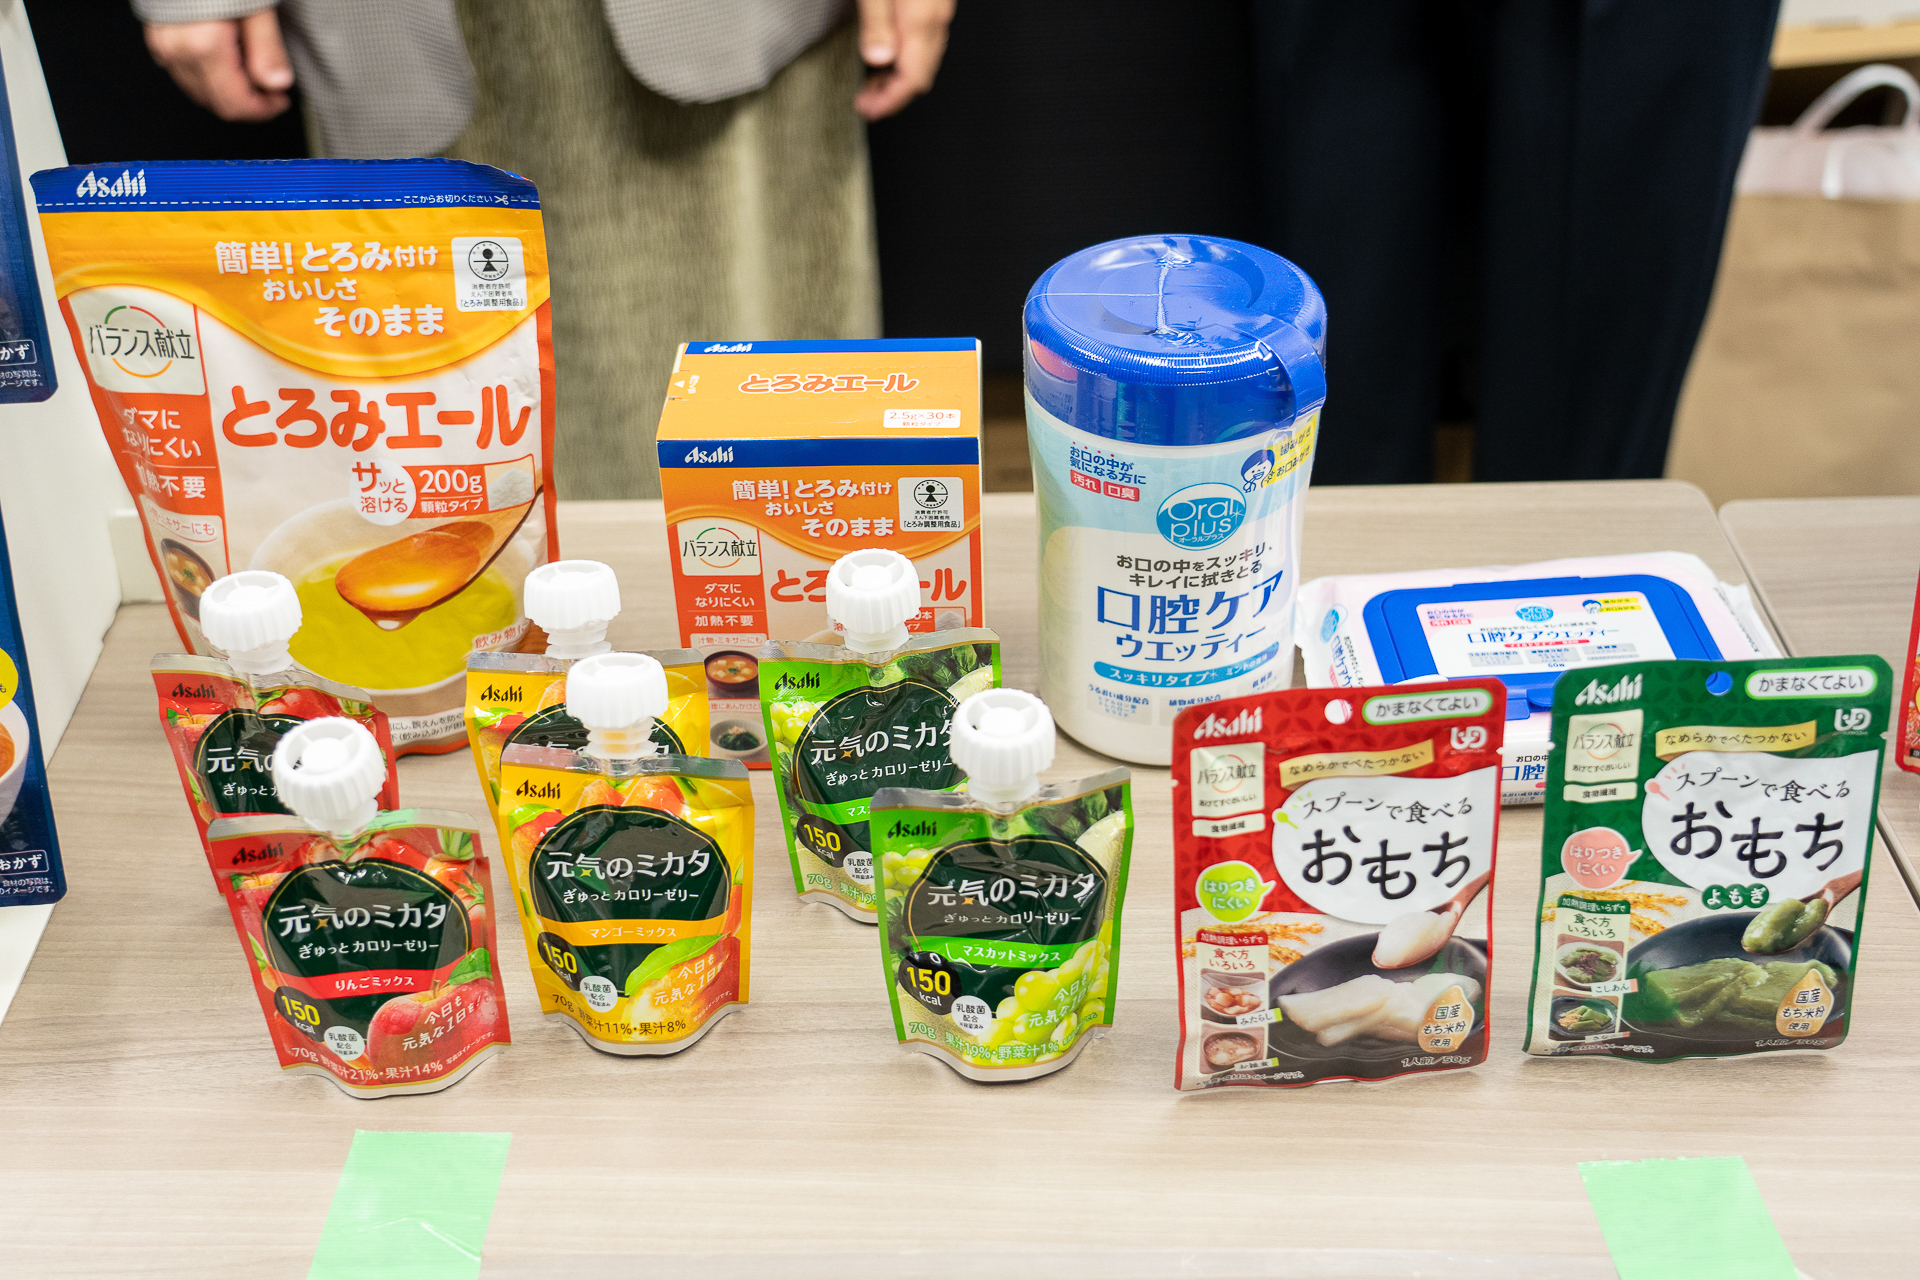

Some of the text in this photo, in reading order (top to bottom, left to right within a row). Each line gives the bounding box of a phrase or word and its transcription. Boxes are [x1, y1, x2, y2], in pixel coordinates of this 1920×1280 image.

[76, 169, 147, 199] Asahi
[403, 194, 493, 205] ここからお切りください
[262, 278, 358, 303] おいしさ
[314, 305, 445, 336] そのまま
[89, 325, 195, 360] バランス献立
[703, 343, 753, 353] Asahi
[738, 373, 920, 393] とろみエール
[124, 407, 181, 430] ダマに
[222, 384, 532, 452] とろみエール
[889, 411, 956, 420] 2.5g×30本
[122, 427, 202, 459] なりにくい
[684, 446, 734, 464] Asahi
[1070, 446, 1134, 472] お口の中が
[352, 461, 406, 494] サッと
[1070, 456, 1146, 484] 気になる方に
[419, 469, 483, 494] 200g
[1073, 472, 1135, 500] 汚れ 口臭
[361, 496, 408, 513] 溶ける
[421, 498, 483, 514] 顆粒タイプ
[765, 501, 834, 516] おいしさ
[1168, 498, 1234, 521] Oral
[801, 517, 894, 537] そのまま
[1171, 518, 1231, 541] plus
[1179, 533, 1225, 543] オーラルプラス
[683, 539, 757, 557] バランス献立
[1129, 559, 1263, 589] キレイに拭きとる
[704, 583, 742, 594] ダマに
[695, 597, 755, 607] なりにくい
[1097, 570, 1284, 635] 口腔ケア
[695, 615, 754, 627] 加熱不要
[475, 621, 528, 649] 飲み物に
[1116, 626, 1266, 662] ウエッティー
[775, 672, 821, 691] Asahi
[1109, 668, 1209, 687] スッキリタイプ
[1758, 674, 1865, 693] かまなくてよい
[172, 682, 216, 699] Asahi
[481, 684, 522, 702] Asahi
[1575, 673, 1643, 707] Asahi
[1375, 696, 1479, 718] かまなくてよい
[1193, 705, 1262, 740] Asahi
[1573, 733, 1634, 750] バランス献立
[1664, 730, 1808, 745] なめらかでべたつかない
[1288, 750, 1425, 775] なめらかでべたつかない
[1197, 764, 1256, 784] バランス献立
[224, 783, 268, 796] ぎゅっと
[516, 779, 561, 800] Asahi
[1677, 767, 1850, 804] スプーンで食べる
[1303, 790, 1473, 824] スプーンで食べる
[803, 824, 841, 852] 150
[888, 821, 937, 839] Asahi
[1670, 801, 1845, 879] おもち
[232, 842, 284, 865] Asahi
[816, 845, 835, 860] kcal
[1570, 844, 1622, 860] はりつき
[546, 849, 711, 880] 元気のミカタ
[1302, 825, 1471, 900] おもち
[1577, 863, 1615, 876] にくい
[807, 874, 832, 889] 70g
[927, 872, 1095, 907] 元気のミカタ
[1203, 877, 1256, 894] はりつき
[562, 888, 700, 904] ぎゅっと カロリーゼリー
[1212, 897, 1250, 910] にくい
[1562, 898, 1627, 912] 加熱調理いらずで
[1705, 887, 1766, 906] よもぎ
[279, 902, 448, 937] 元気のミカタ
[943, 911, 1082, 925] ぎゅっと カロリーゼリー
[1573, 913, 1610, 928] 食べ方
[589, 925, 677, 939] マンゴーミックス
[1200, 932, 1264, 946] 加熱調理いらずで
[1568, 925, 1616, 938] いろいろ
[299, 939, 440, 960] ぎゅっと カロリーゼリー
[543, 942, 578, 974] 150
[962, 944, 1062, 963] マスカットミックス
[1213, 948, 1250, 961] 食べ方
[677, 954, 714, 980] 今日も
[1209, 959, 1255, 970] いろいろ
[335, 974, 415, 992] りんごミックス
[583, 982, 611, 993] 乳酸菌
[907, 967, 951, 996] 150
[1595, 981, 1629, 993] こしあん
[552, 994, 575, 1013] 70g
[590, 993, 606, 1001] 配合
[919, 992, 942, 1007] kcal
[1796, 988, 1820, 1004] 国産
[281, 995, 320, 1026] 150
[424, 995, 462, 1025] 今日も
[956, 1003, 986, 1014] 乳酸菌
[1240, 1009, 1273, 1026] みたらし
[1435, 1004, 1461, 1019] 国産
[1782, 1005, 1825, 1018] もち米粉
[294, 1019, 316, 1035] kcal
[962, 1015, 978, 1023] 配合
[1423, 1021, 1466, 1035] もち米粉
[1788, 1022, 1810, 1031] 使用
[328, 1032, 357, 1042] 乳酸菌
[909, 1022, 936, 1040] 70g
[336, 1042, 352, 1050] 配合
[1430, 1038, 1451, 1047] 使用
[291, 1047, 319, 1062] 70g
